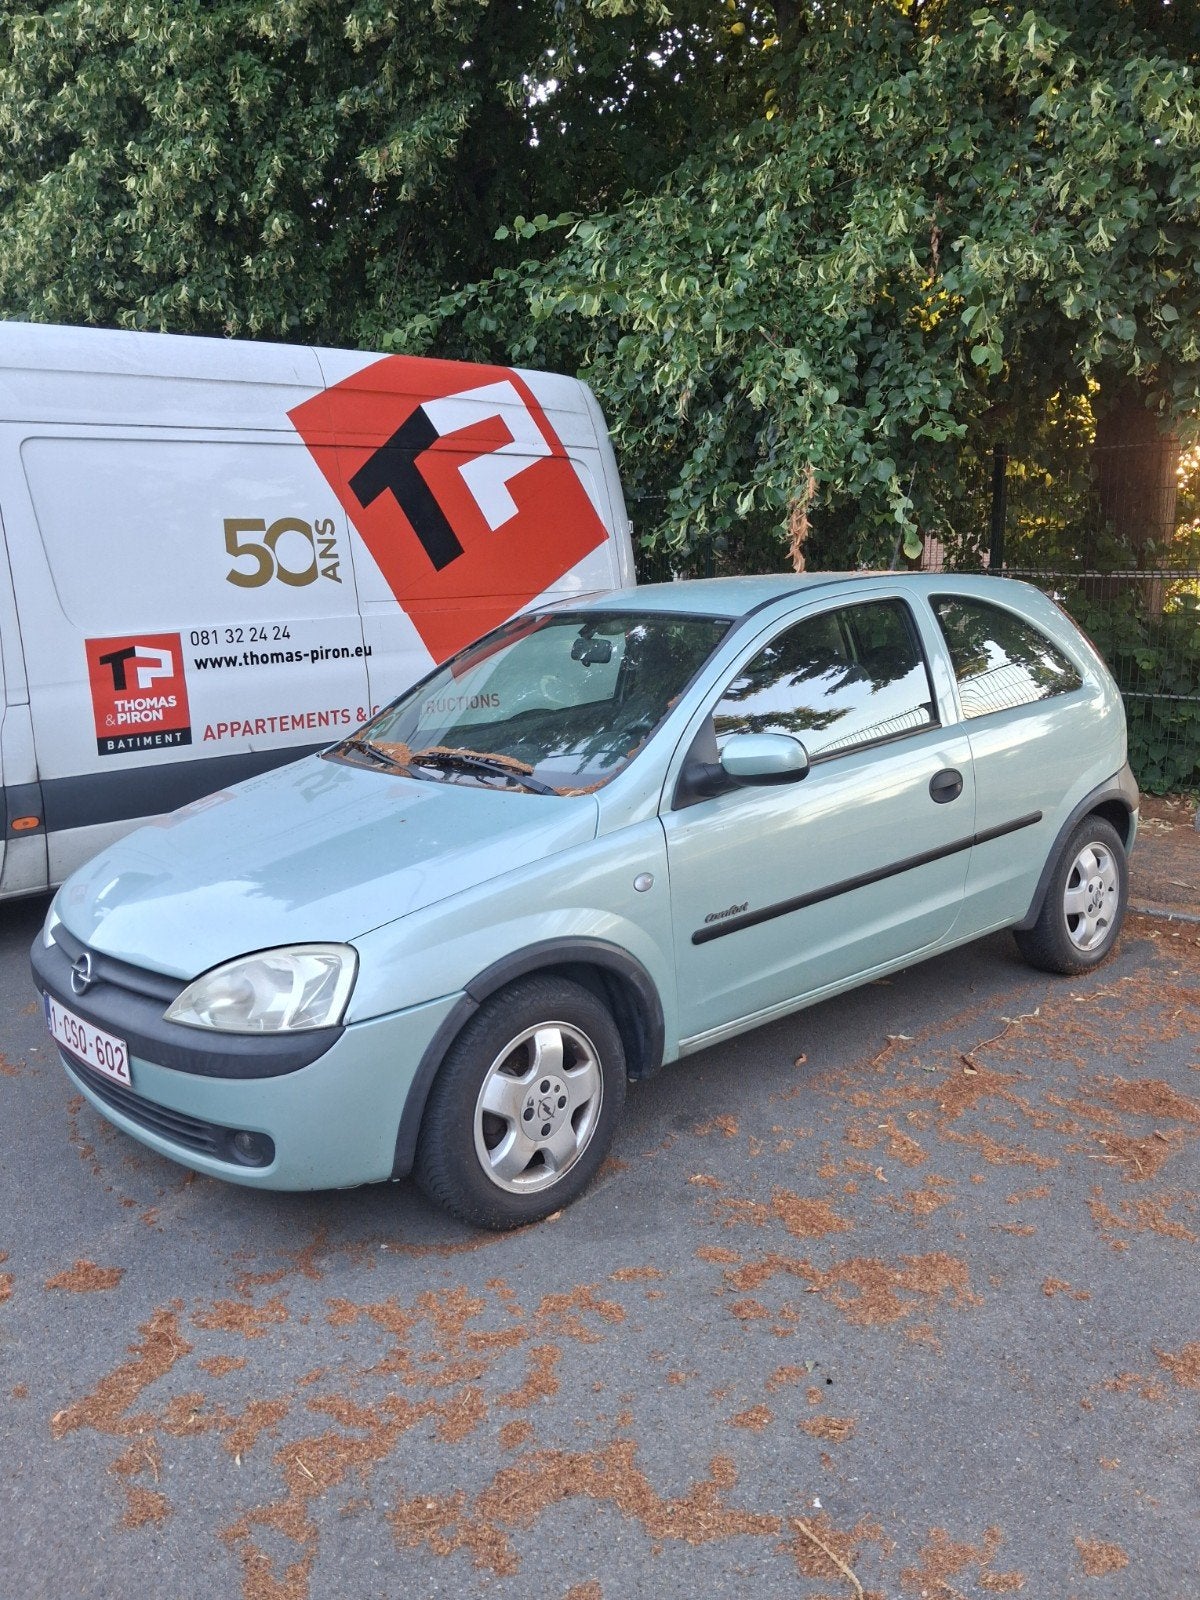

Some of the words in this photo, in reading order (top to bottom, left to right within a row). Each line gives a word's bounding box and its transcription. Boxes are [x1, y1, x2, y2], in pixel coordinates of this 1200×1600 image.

[223, 517, 319, 588] 50
[314, 518, 343, 584] ANS
[190, 630, 219, 646] 081
[225, 628, 244, 644] 32
[250, 626, 268, 642] 24
[272, 625, 291, 641] 24
[194, 645, 372, 670] www.thomas-piron.eu
[114, 695, 177, 712] THOMAS
[203, 708, 351, 741] APPARTEMENTS
[356, 706, 368, 722] &
[107, 732, 182, 751] BATIMENT
